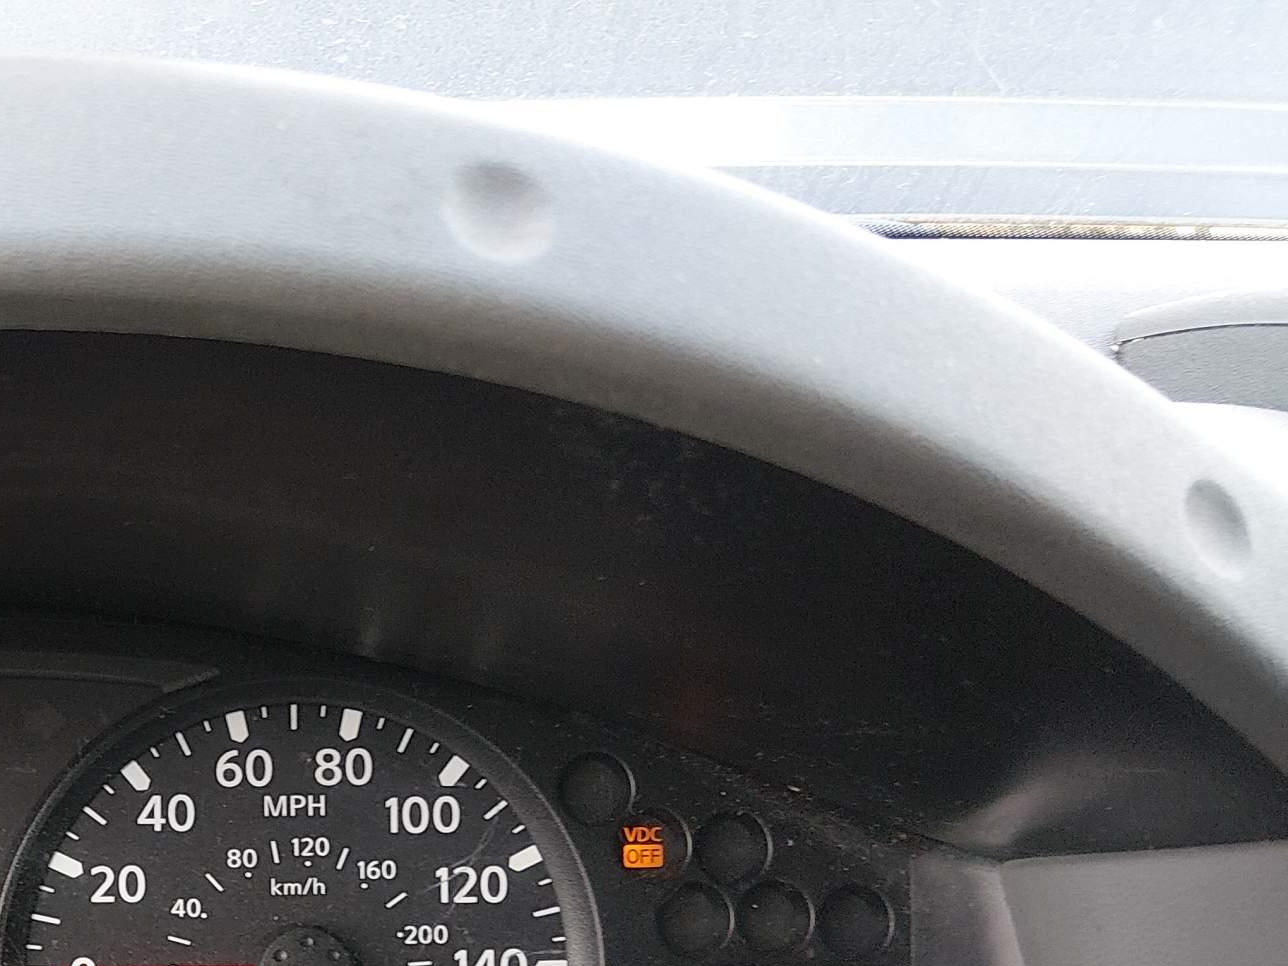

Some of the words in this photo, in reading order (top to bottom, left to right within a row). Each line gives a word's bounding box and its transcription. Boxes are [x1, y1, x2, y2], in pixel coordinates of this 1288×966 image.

[215, 749, 273, 788] 60
[314, 747, 373, 787] 80
[136, 793, 196, 832] 40
[263, 794, 326, 817] MPH
[384, 795, 461, 834] 100
[624, 826, 661, 843] VDC
[291, 836, 330, 857] 120
[626, 847, 662, 864] OFF
[226, 848, 258, 869] 80
[356, 860, 397, 880] 160
[90, 864, 146, 904] 20
[270, 877, 326, 896] km/h
[434, 865, 508, 904] 120
[170, 898, 200, 919] 40
[403, 924, 449, 945] 200
